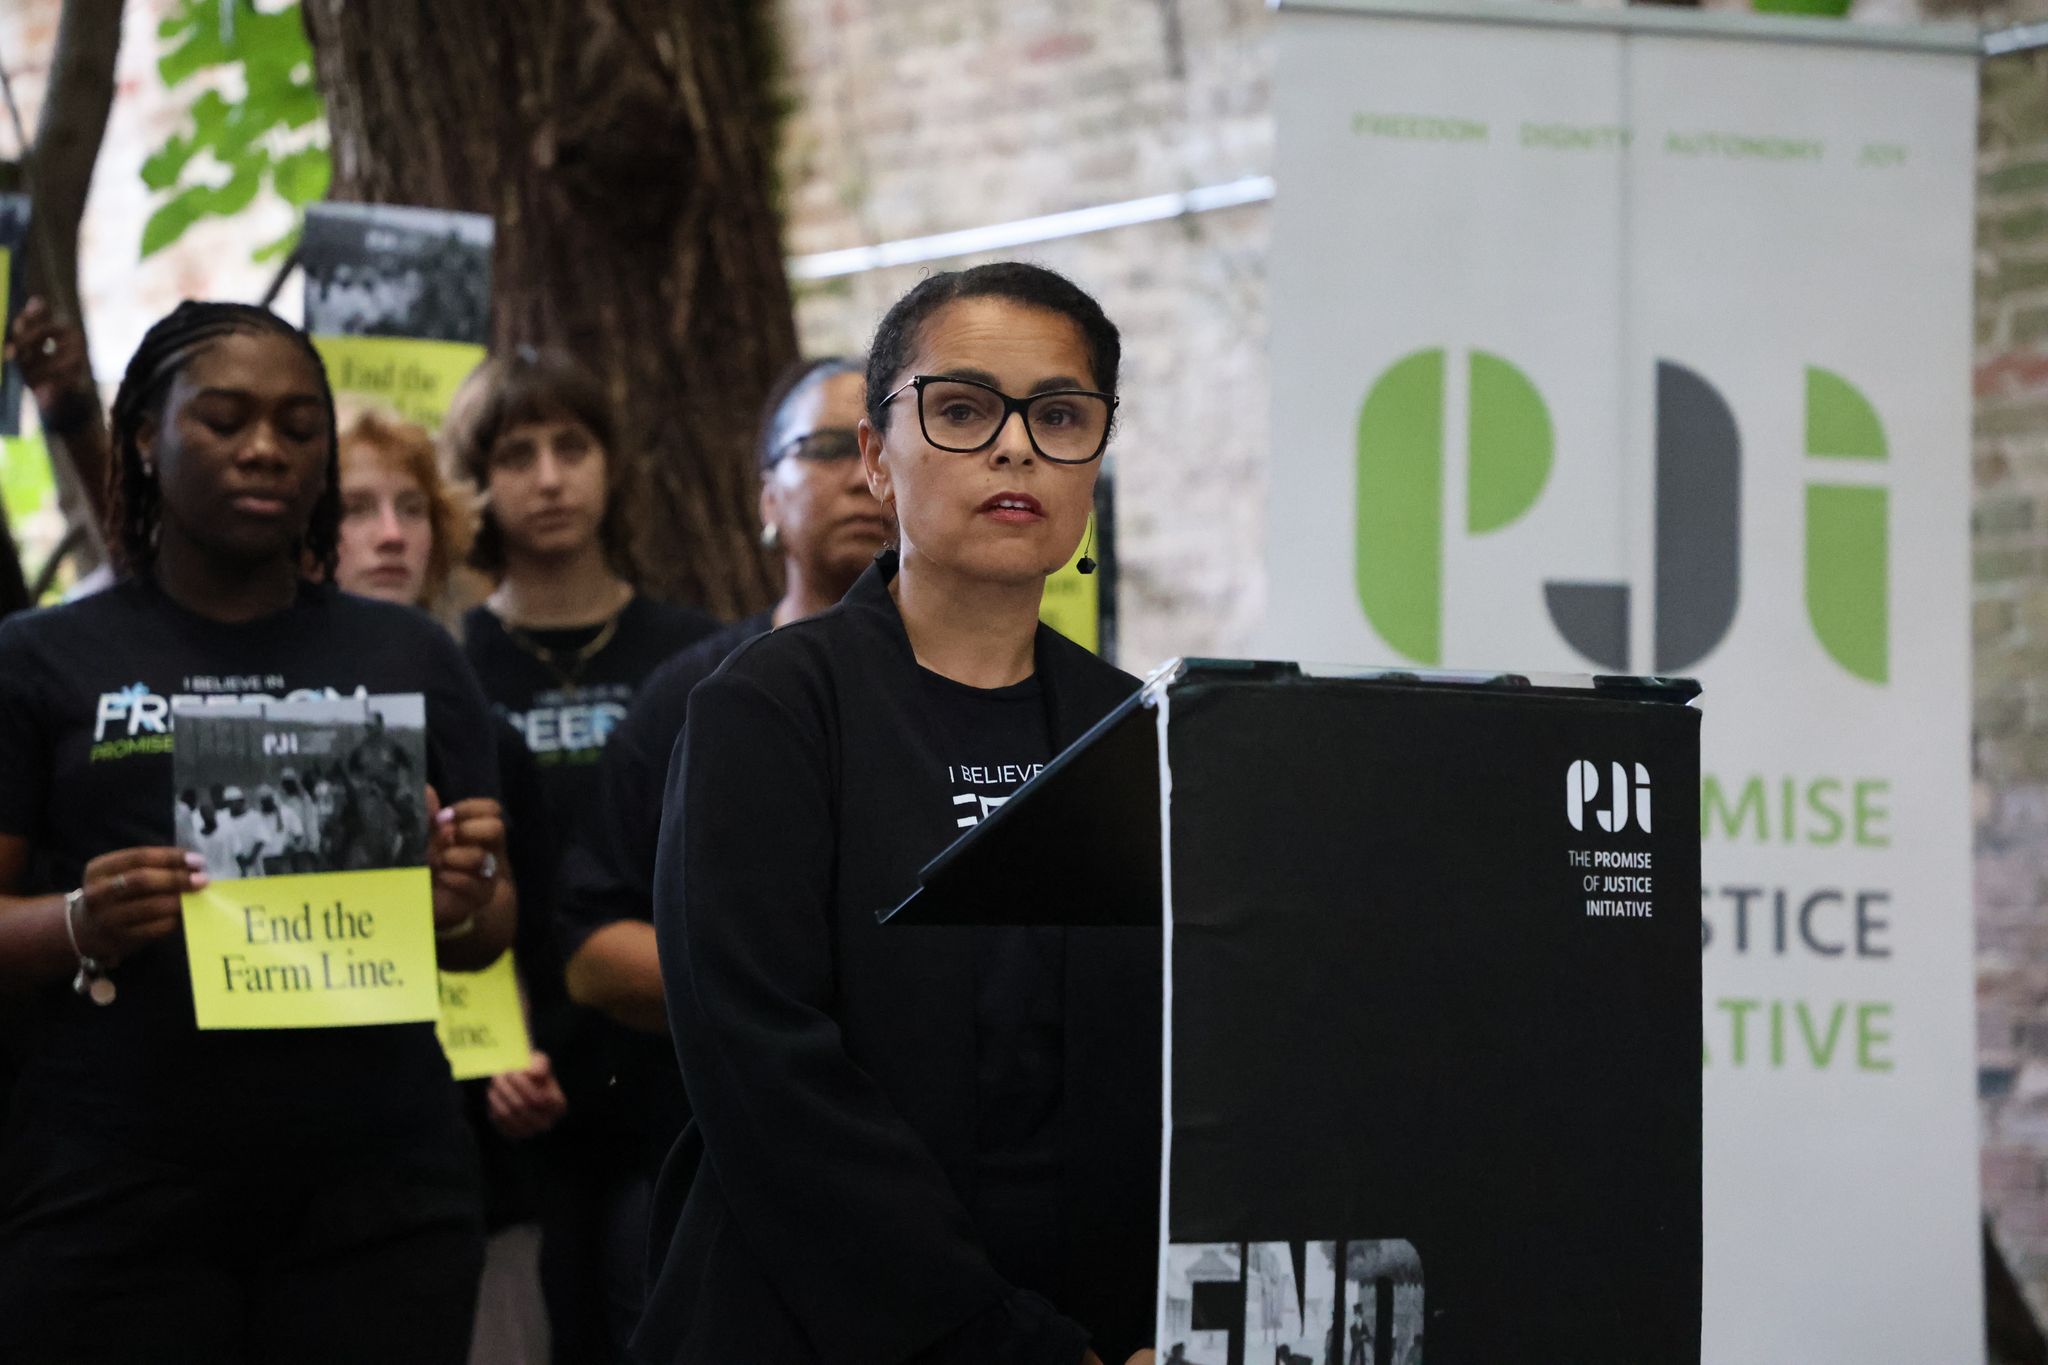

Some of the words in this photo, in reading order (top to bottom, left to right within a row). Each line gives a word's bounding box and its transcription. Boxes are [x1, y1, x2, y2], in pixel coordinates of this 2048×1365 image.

[1568, 850, 1592, 867] THE
[1594, 851, 1652, 869] PROMISE
[1583, 875, 1600, 892] OF
[1603, 876, 1652, 893] JUSTICE
[244, 902, 312, 944] End
[323, 901, 374, 940] the
[1586, 900, 1653, 918] INITIATIVE
[222, 954, 312, 992] Farm
[322, 948, 404, 990] Line.
[1164, 1238, 1424, 1365] END
